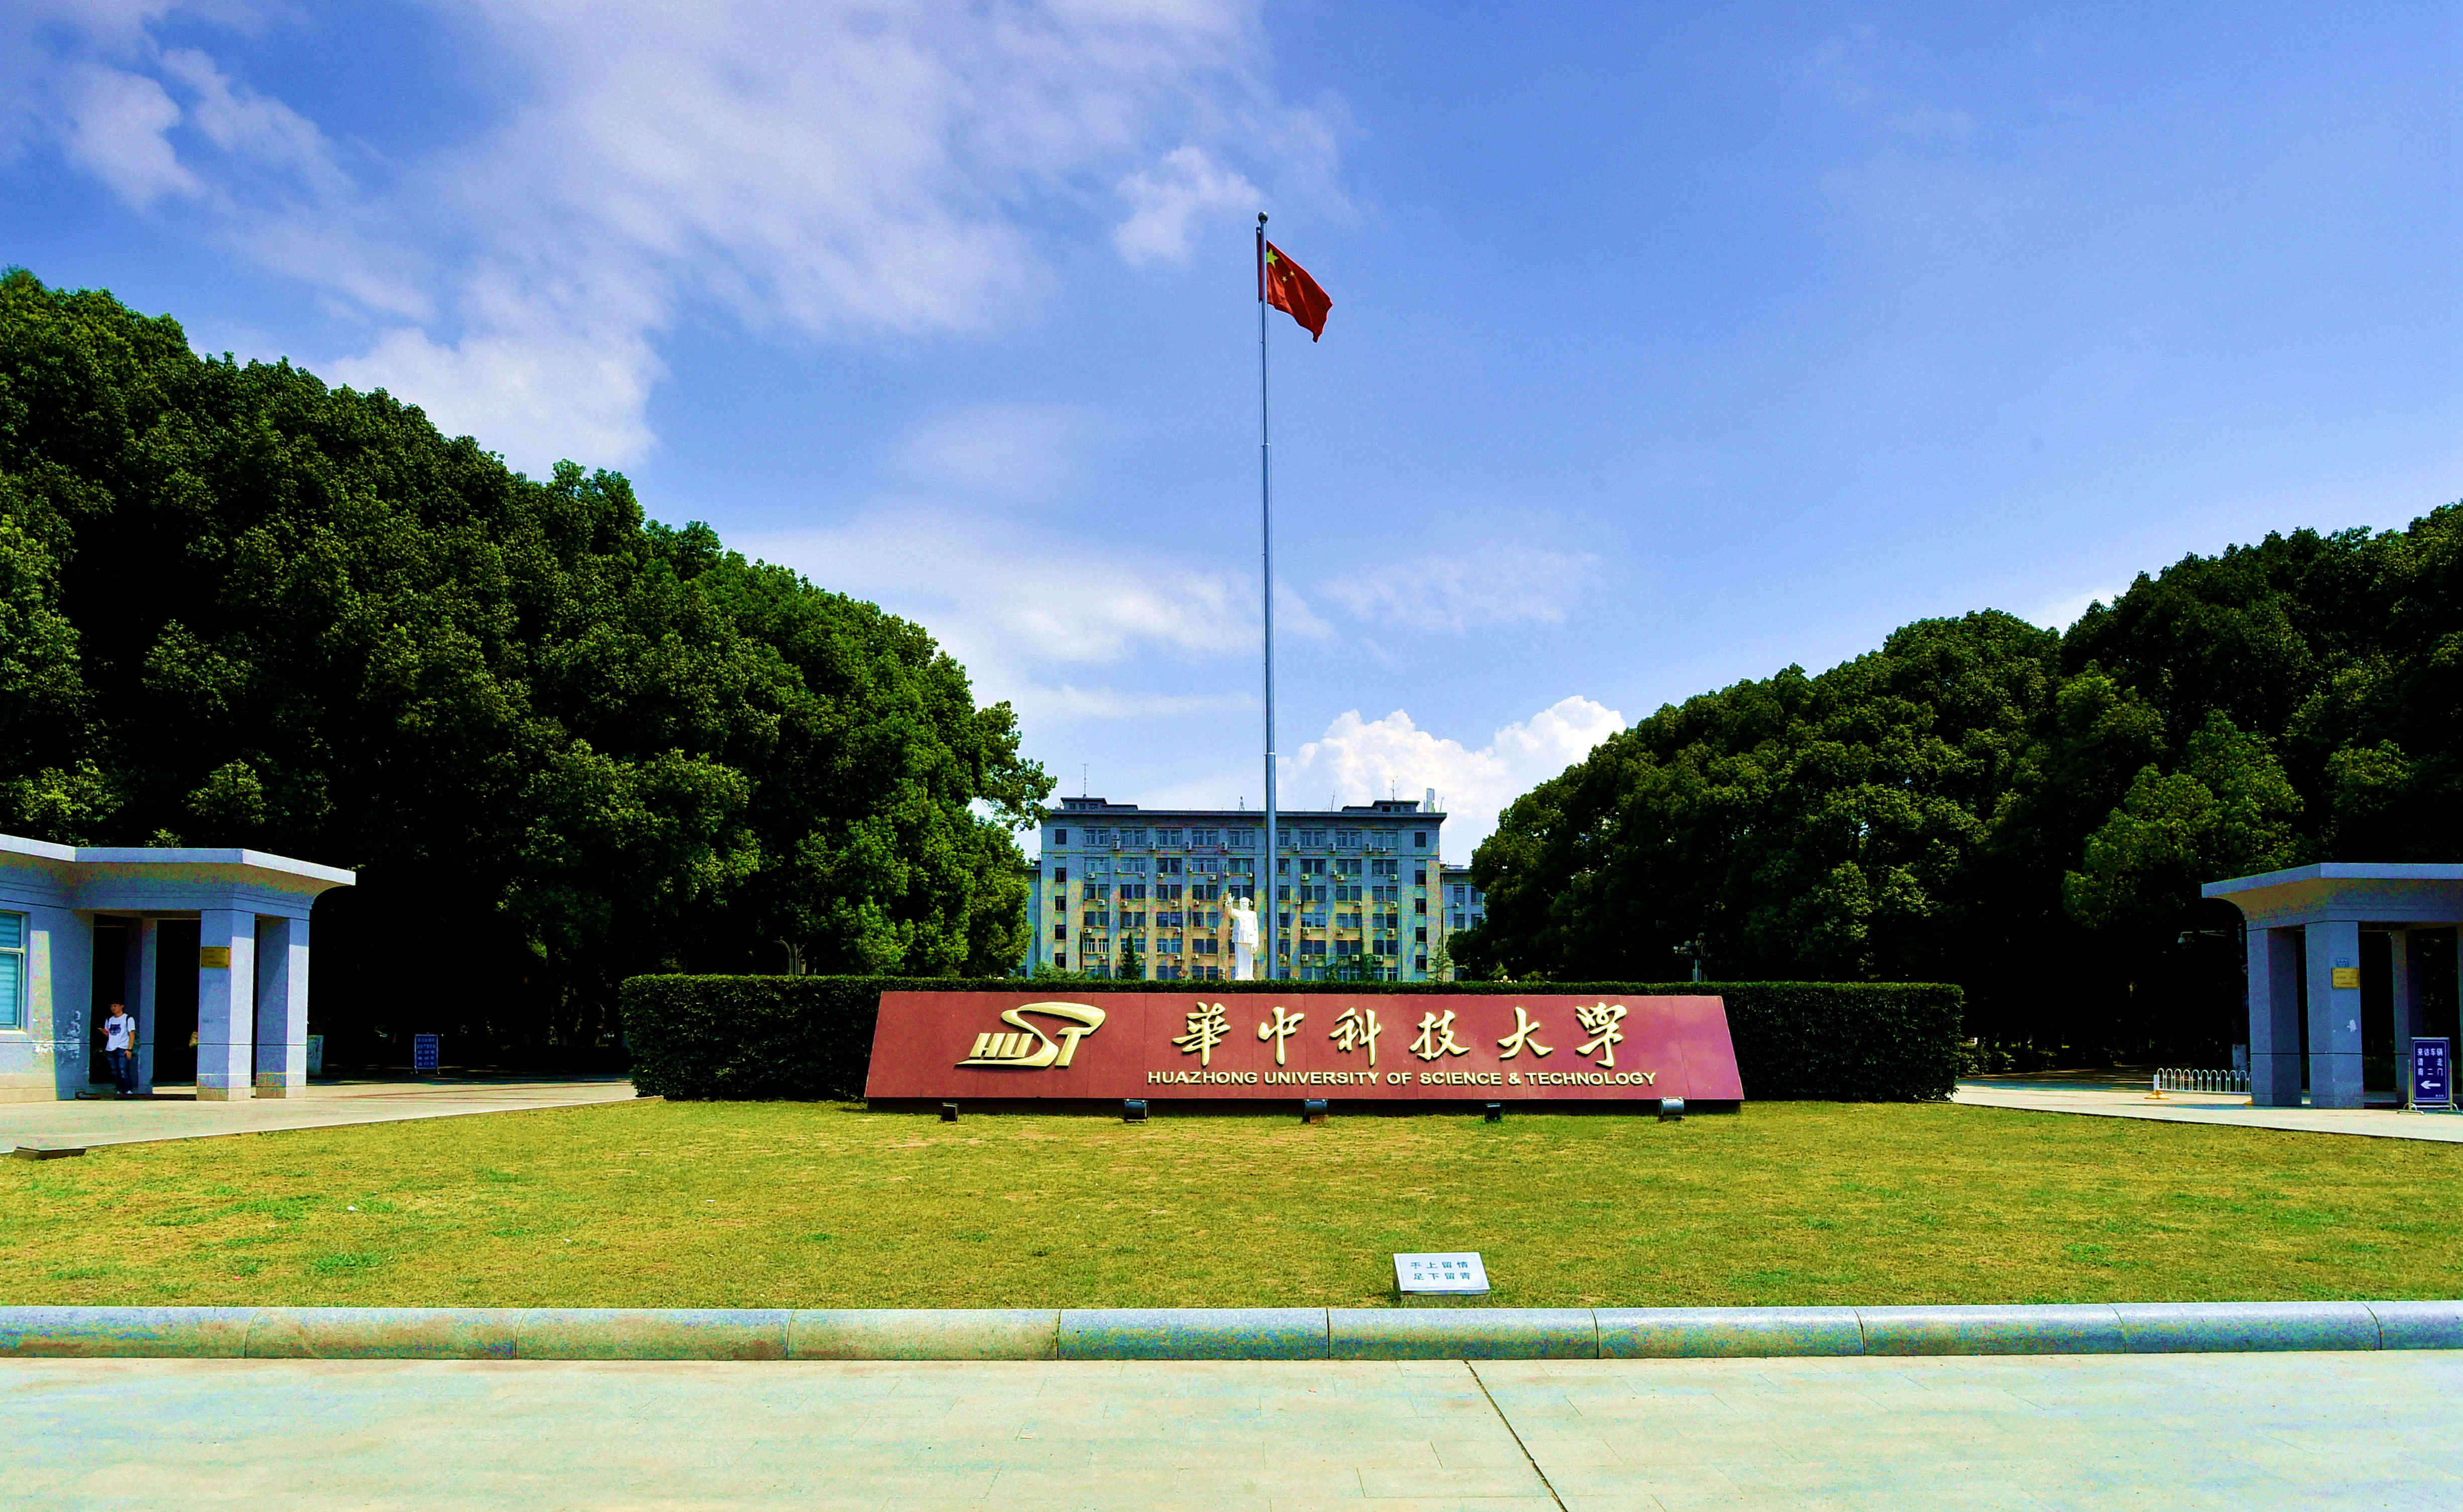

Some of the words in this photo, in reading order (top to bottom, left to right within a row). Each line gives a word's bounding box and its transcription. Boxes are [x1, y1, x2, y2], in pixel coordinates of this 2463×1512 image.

[955, 1002, 1106, 1067] HUST
[1148, 1072, 1258, 1084] HUAZHONG
[1264, 1072, 1380, 1085] UNIVERSITY
[1387, 1072, 1412, 1085] OF
[1420, 1072, 1503, 1085] SCIENCE
[1508, 1072, 1520, 1085] &
[1525, 1072, 1656, 1086] TECHNOLOGY
